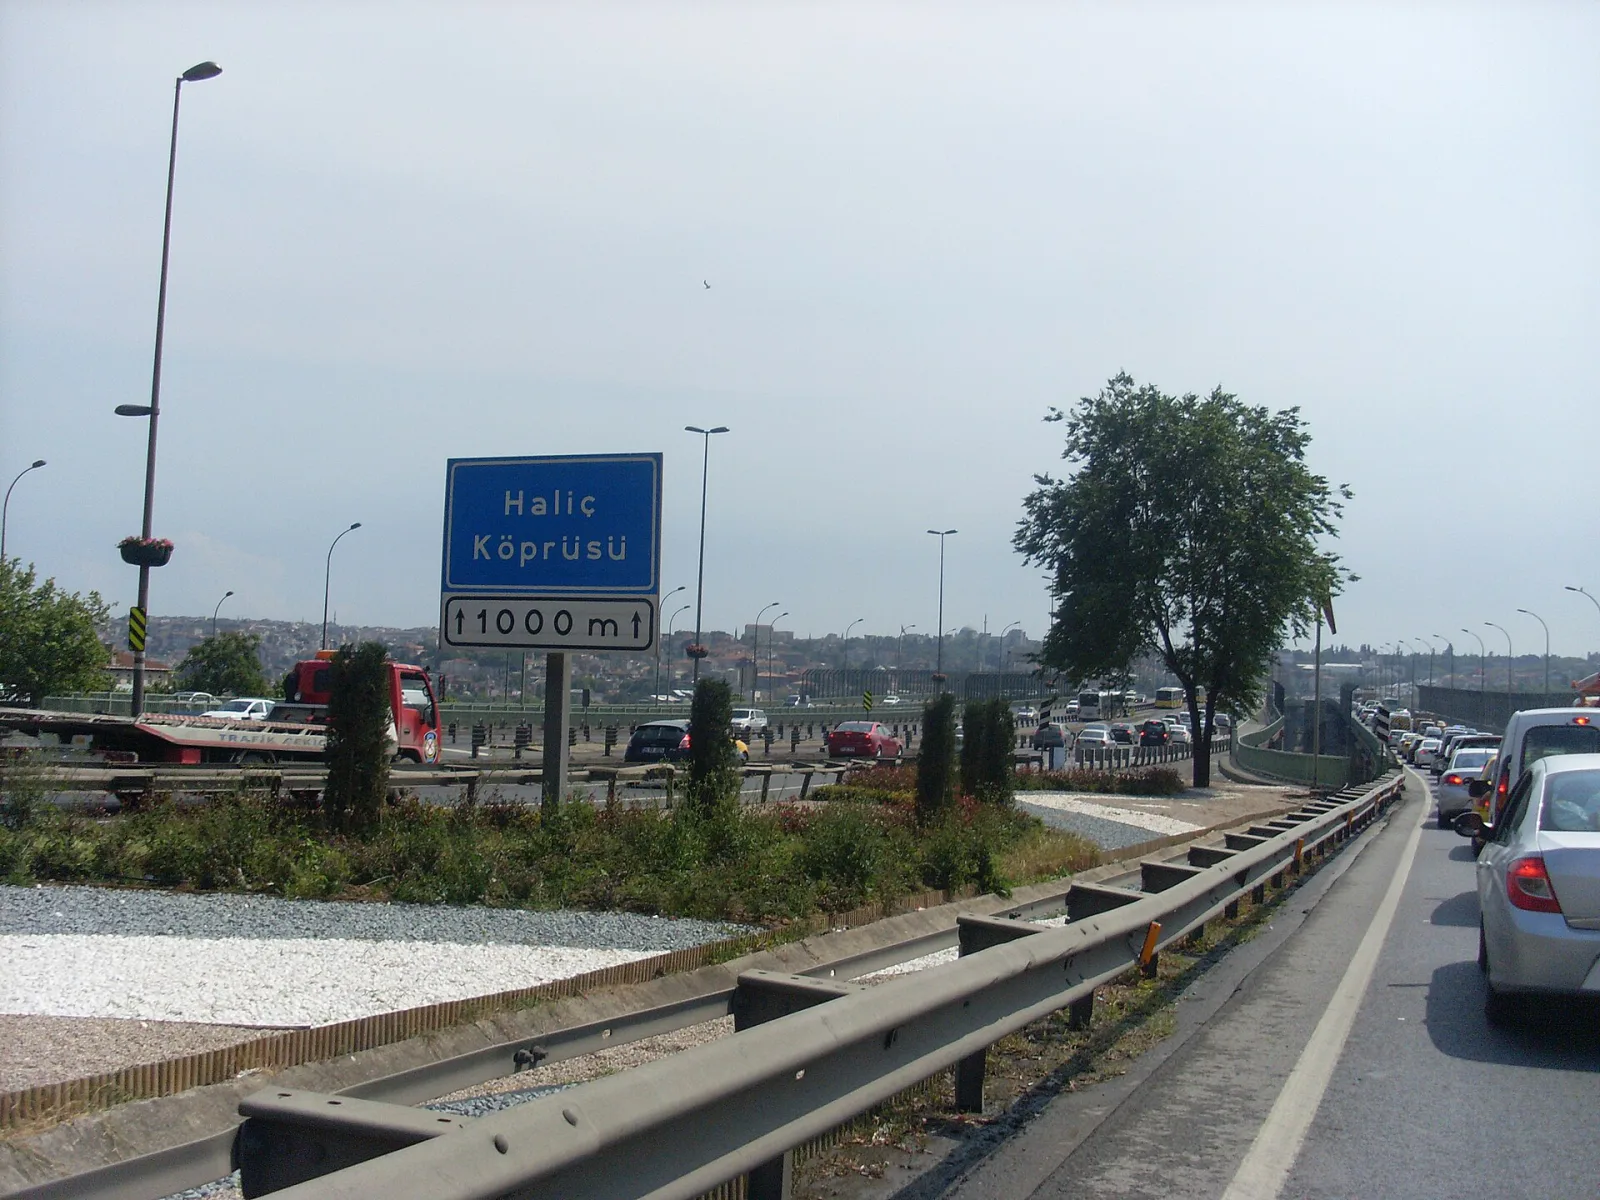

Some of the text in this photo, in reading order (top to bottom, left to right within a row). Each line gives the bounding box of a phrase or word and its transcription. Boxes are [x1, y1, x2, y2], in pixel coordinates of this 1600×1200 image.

[504, 489, 596, 518] Haliç
[473, 534, 626, 567] Köprüsü
[476, 608, 618, 637] 1000 m
